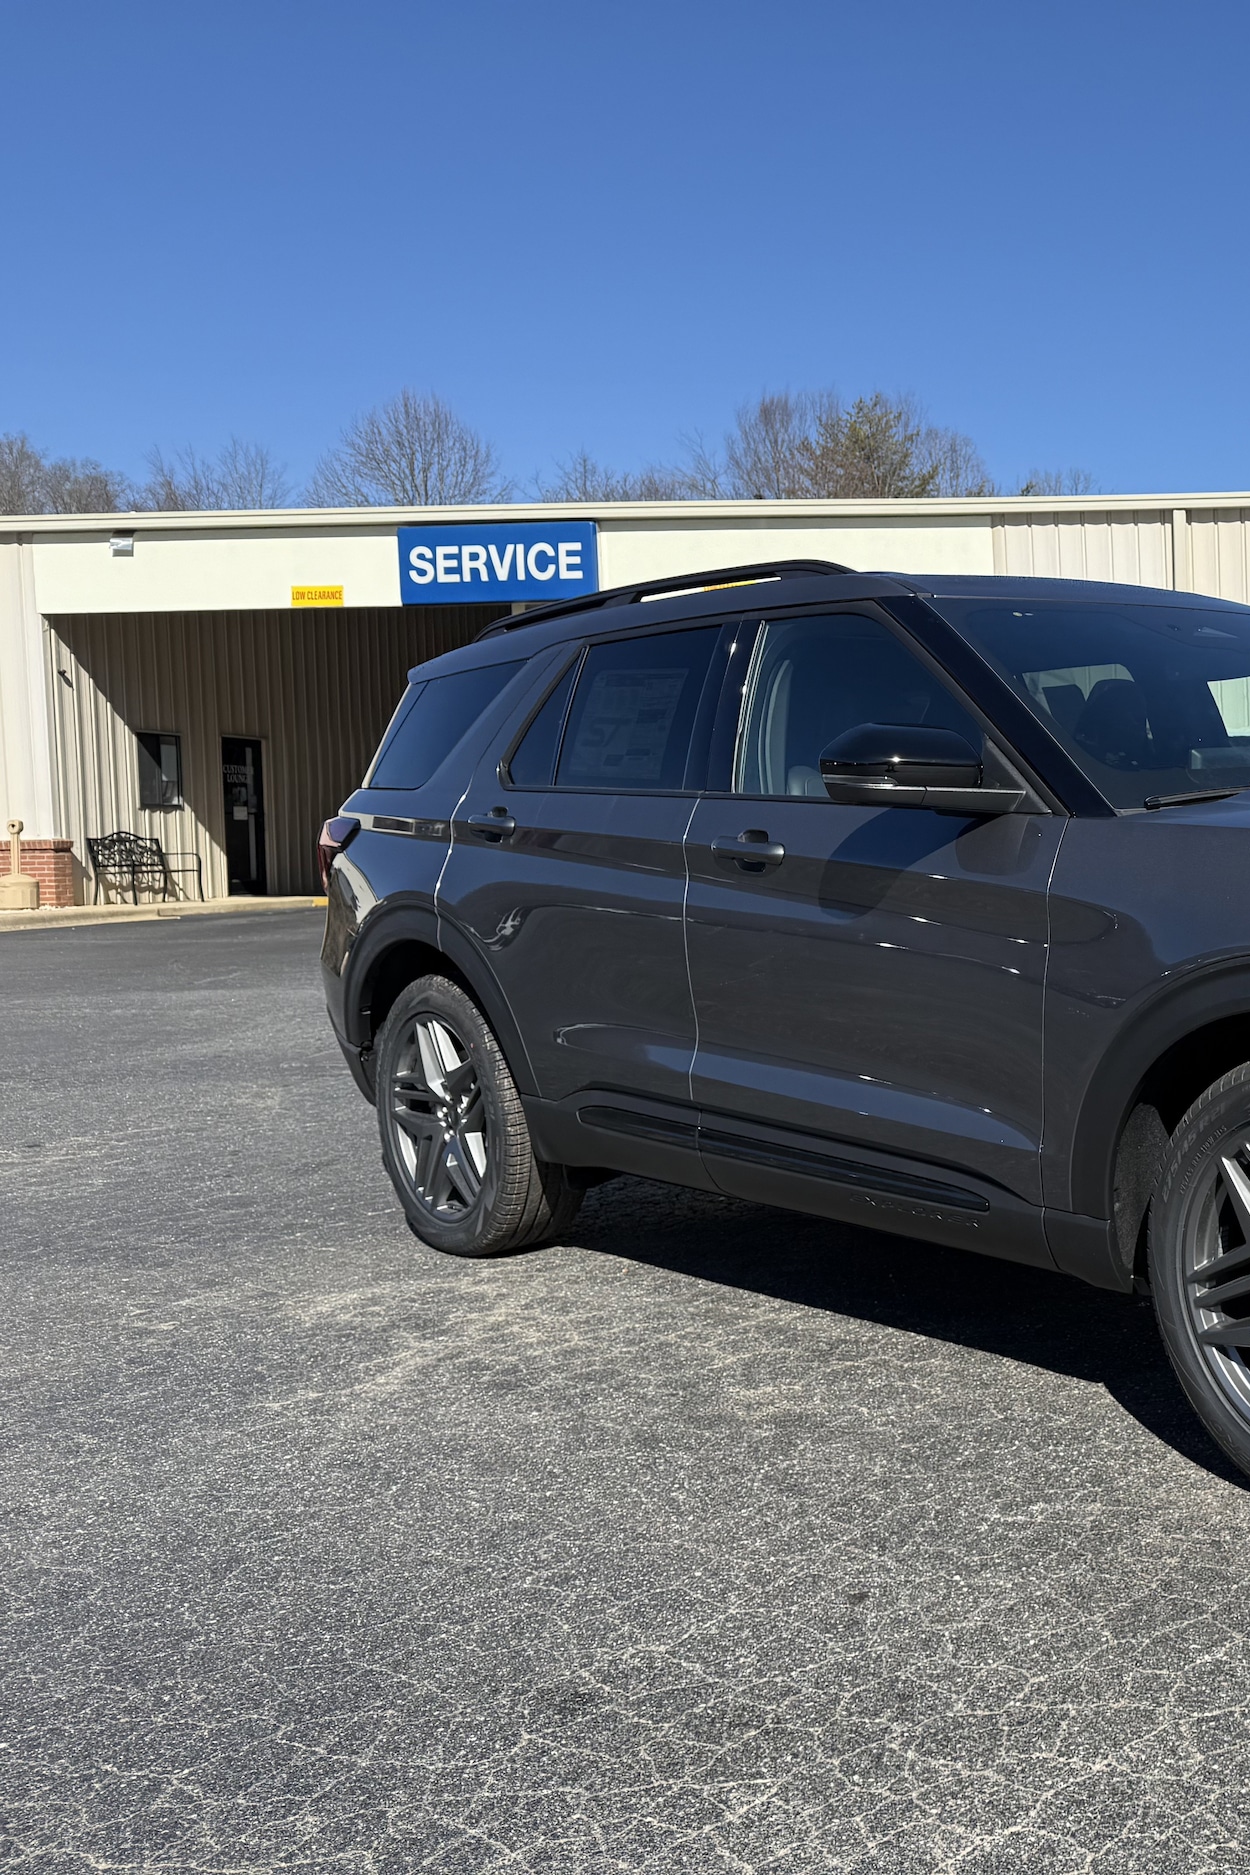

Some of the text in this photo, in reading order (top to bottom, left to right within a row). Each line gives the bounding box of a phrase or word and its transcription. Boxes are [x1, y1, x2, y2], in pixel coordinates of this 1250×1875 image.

[408, 541, 583, 585] SERVICE
[292, 590, 343, 601] LOW CLEARANCE
[849, 1192, 981, 1231] EXPLORER
